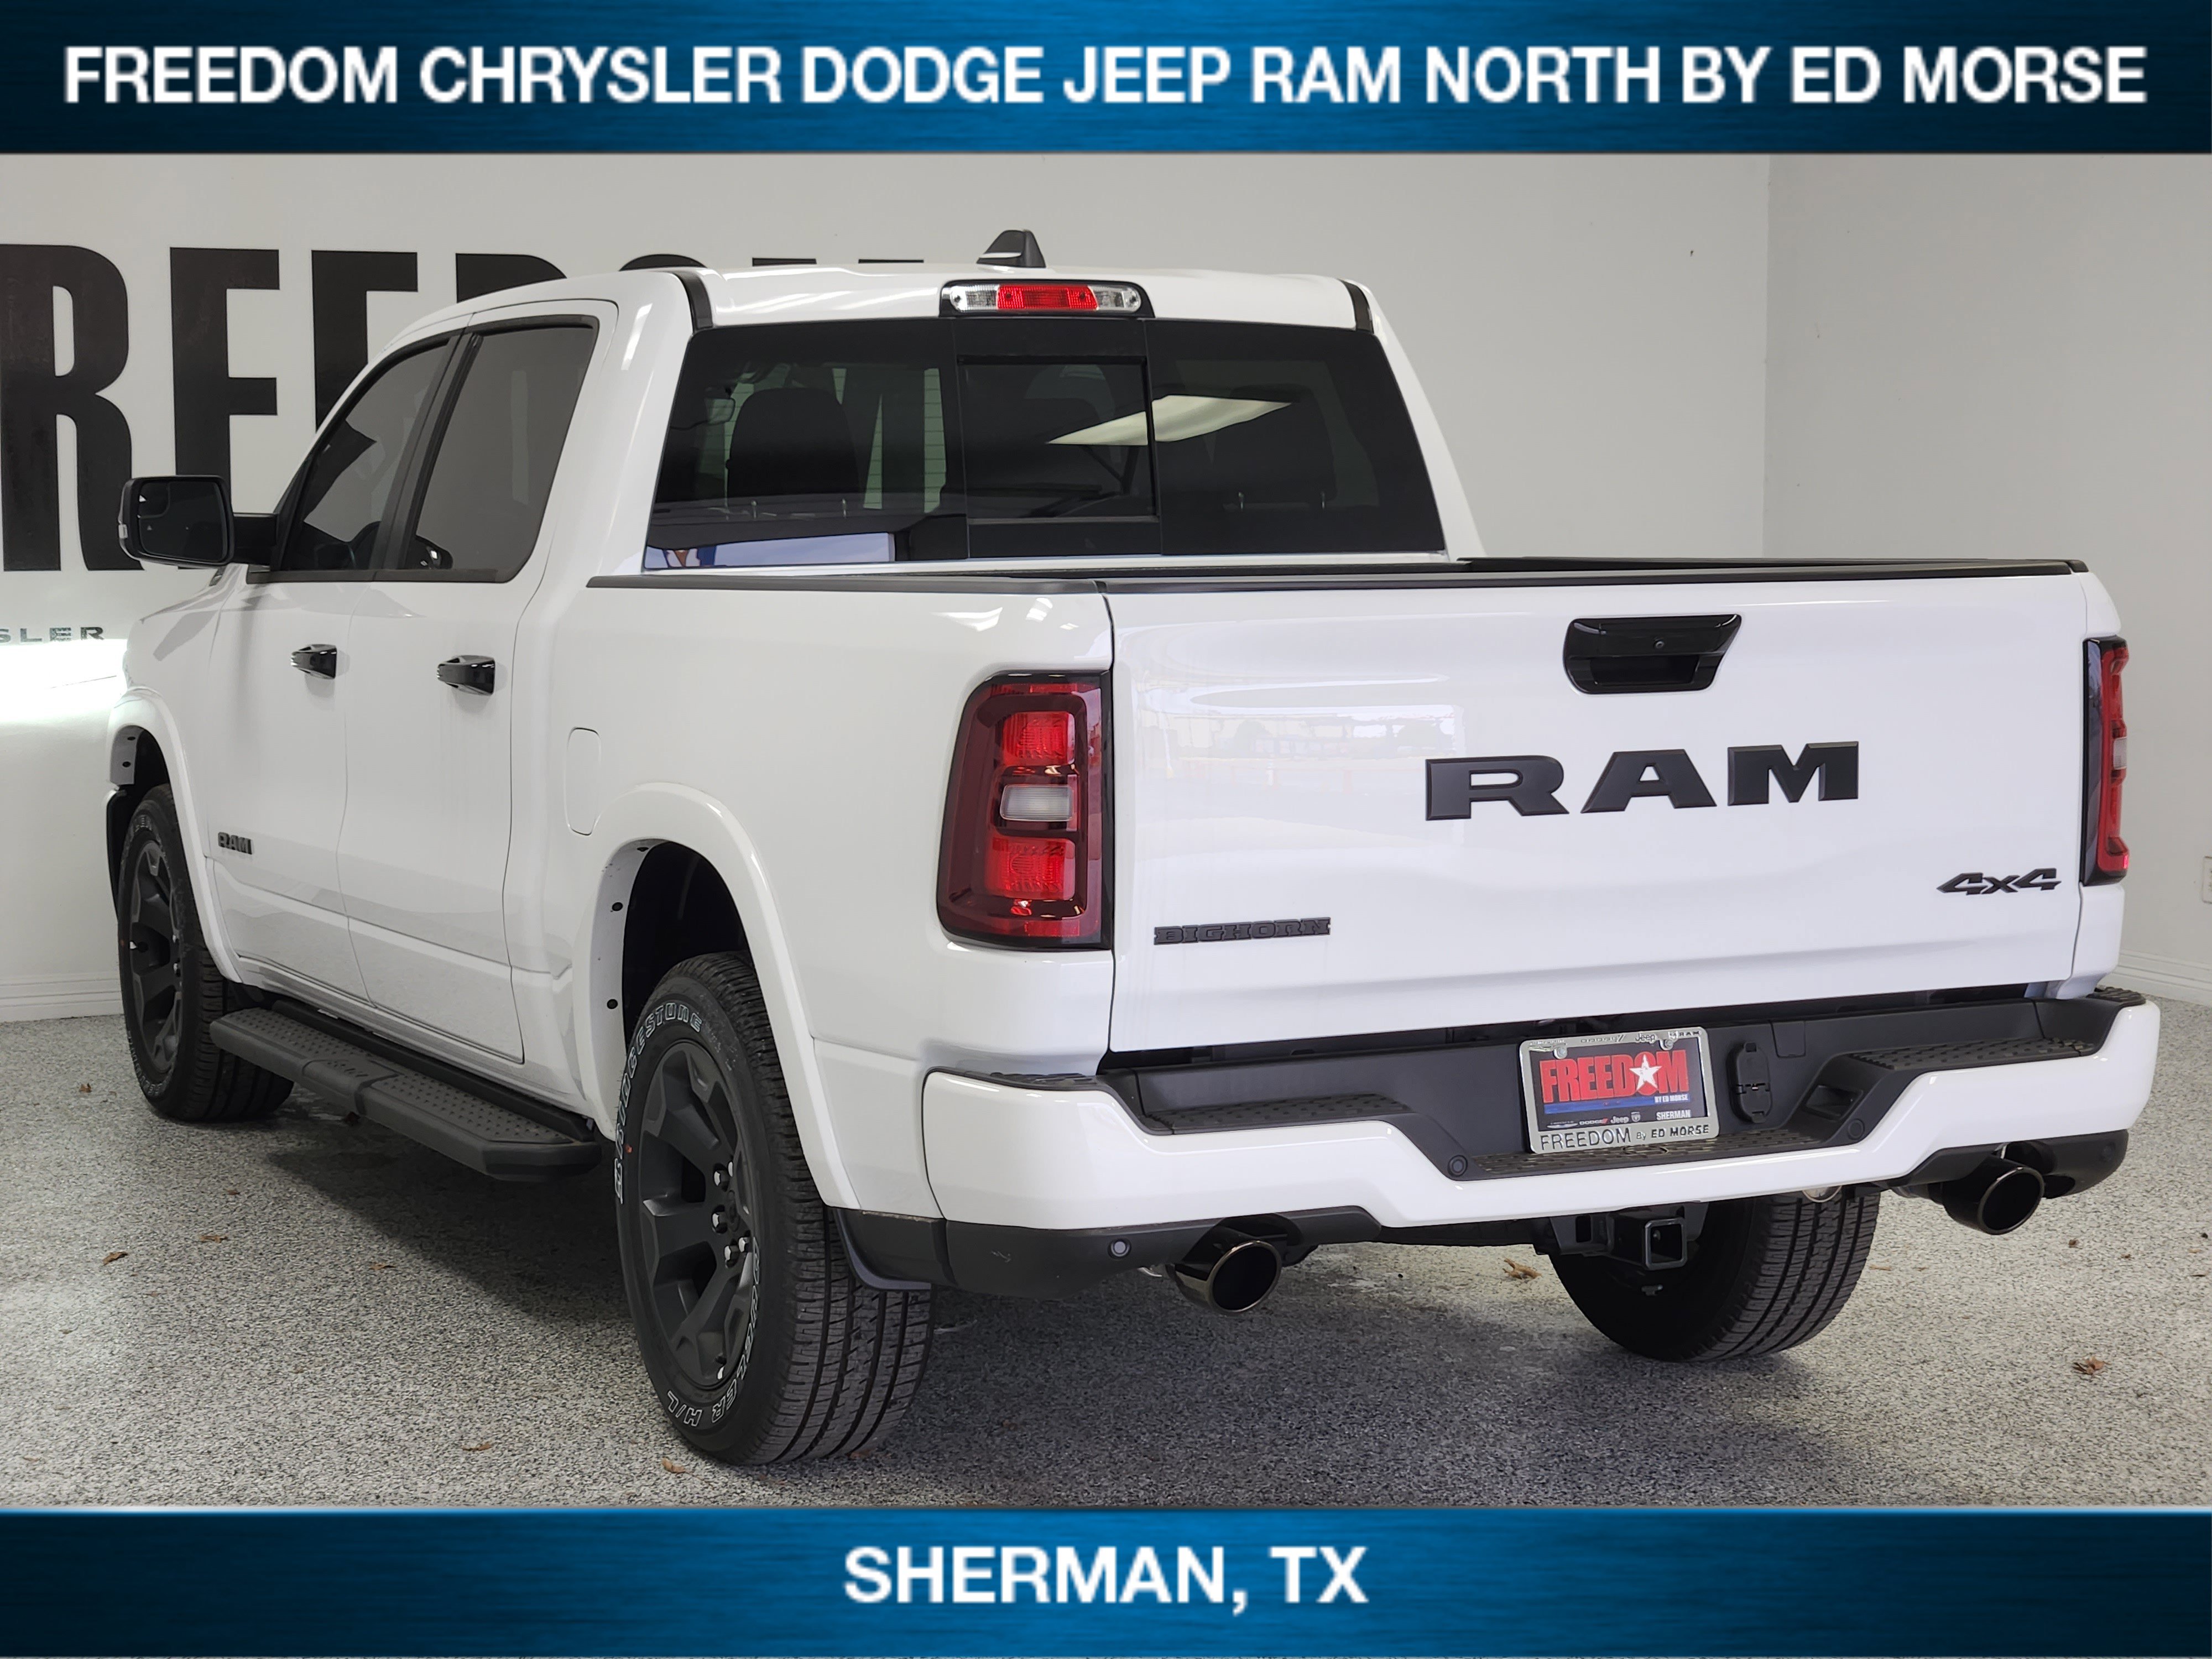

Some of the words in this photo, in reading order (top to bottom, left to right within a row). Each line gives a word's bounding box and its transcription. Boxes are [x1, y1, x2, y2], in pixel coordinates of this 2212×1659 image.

[1426, 741, 1859, 821] RAM
[218, 832, 252, 855] RAM
[1937, 868, 2062, 895] 4x4
[1154, 917, 1331, 945] BIGHORN
[1635, 1034, 1656, 1044] Jeep
[1540, 1050, 1689, 1103] FREEDOM
[1610, 1115, 1629, 1124] Jeep
[1656, 1109, 1691, 1120] SHERMAN
[1541, 1127, 1632, 1150] FREEDOM
[1651, 1129, 1665, 1138] ED
[1670, 1124, 1709, 1137] MORSE
